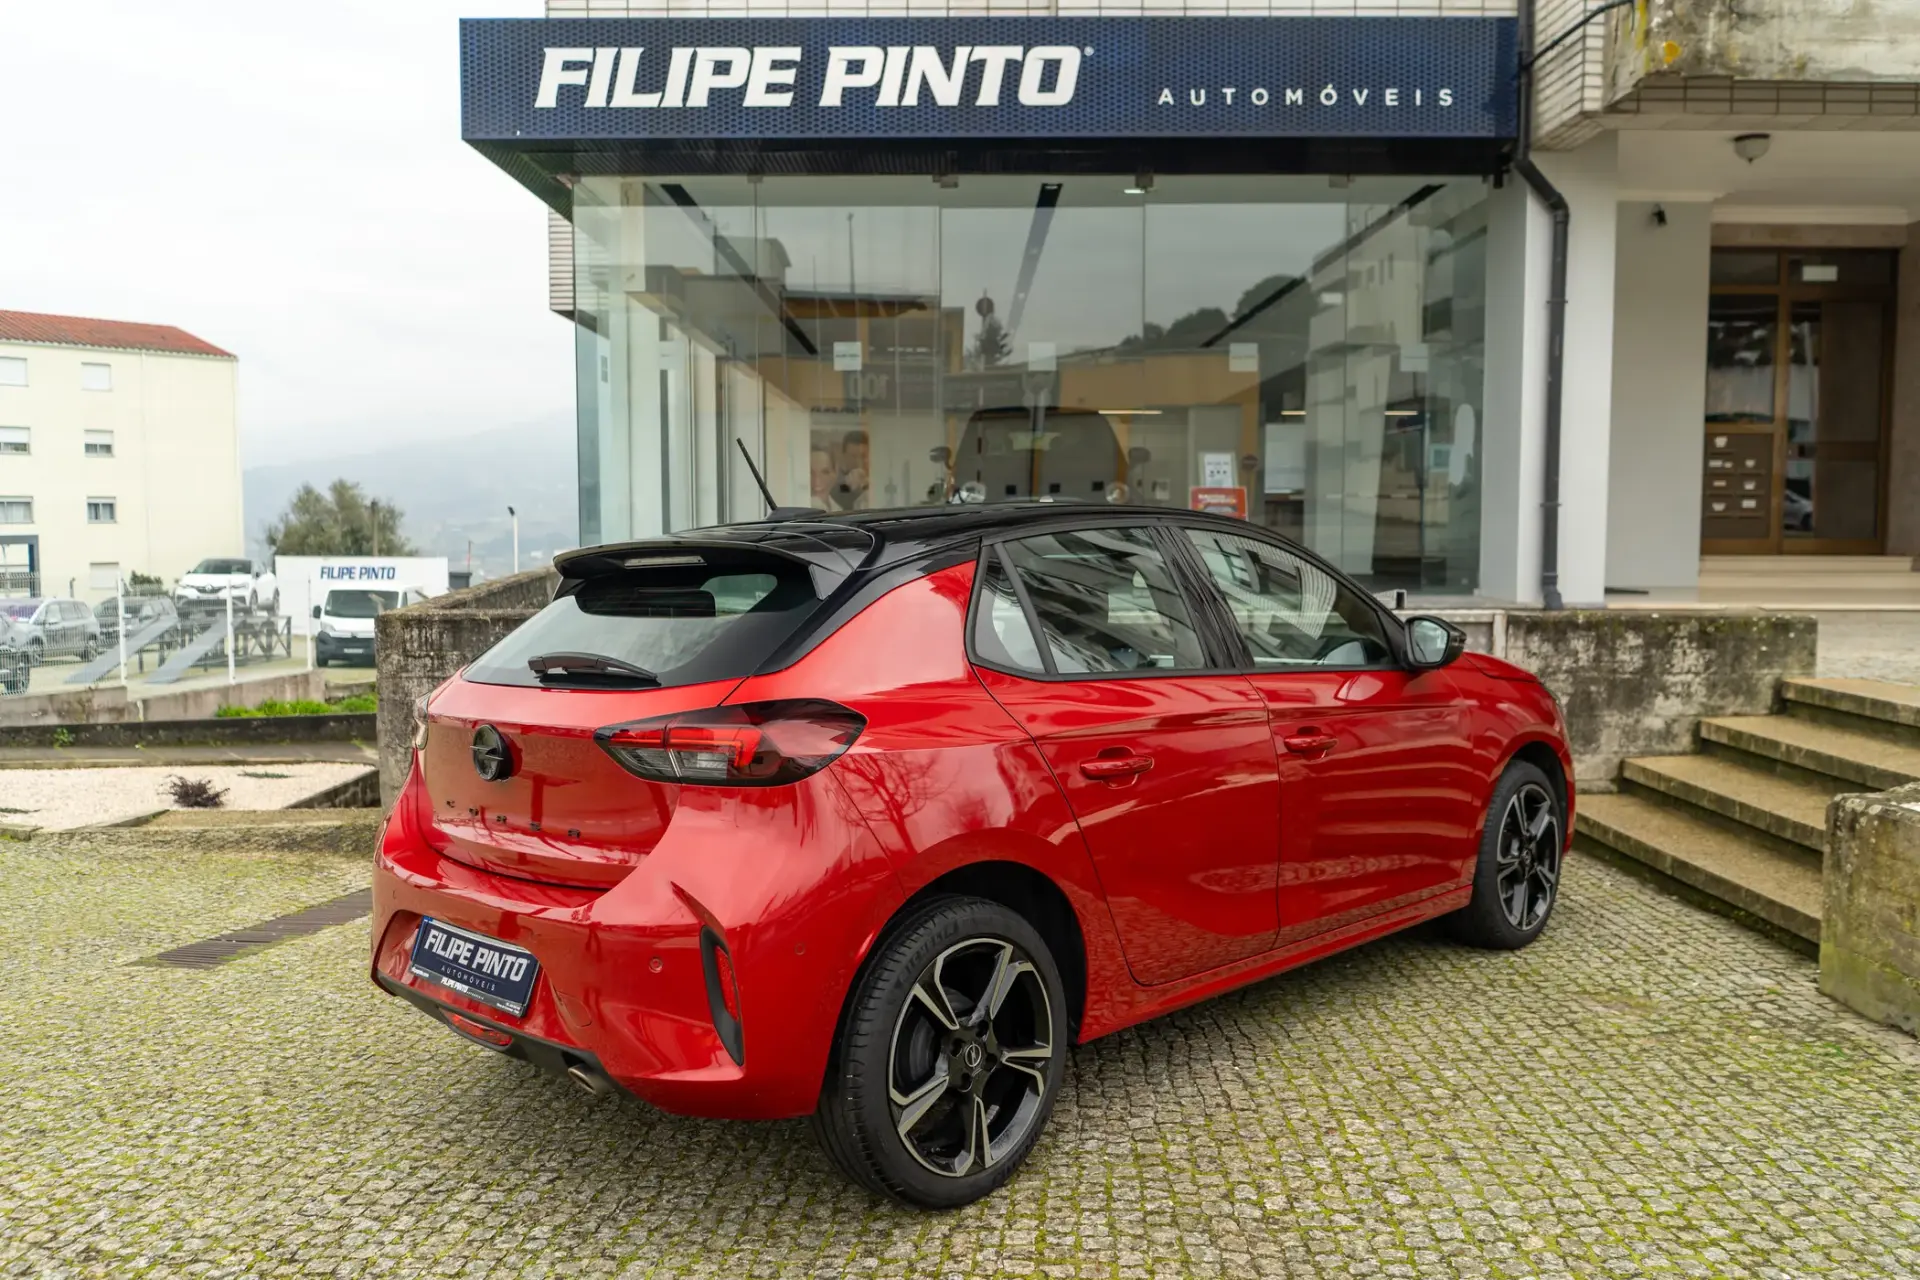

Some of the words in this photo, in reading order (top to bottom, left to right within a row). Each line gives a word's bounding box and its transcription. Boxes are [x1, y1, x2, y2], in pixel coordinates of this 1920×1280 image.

[534, 46, 801, 108] FILIPE
[819, 45, 1081, 107] PINTO
[1157, 83, 1454, 107] AUTOMÓVEIS
[320, 566, 356, 580] FILIPE
[359, 566, 396, 580] PINTO
[424, 929, 474, 966] FILIPE
[472, 946, 526, 982] PINTO
[441, 965, 496, 991] AUTOMÓVEIS
